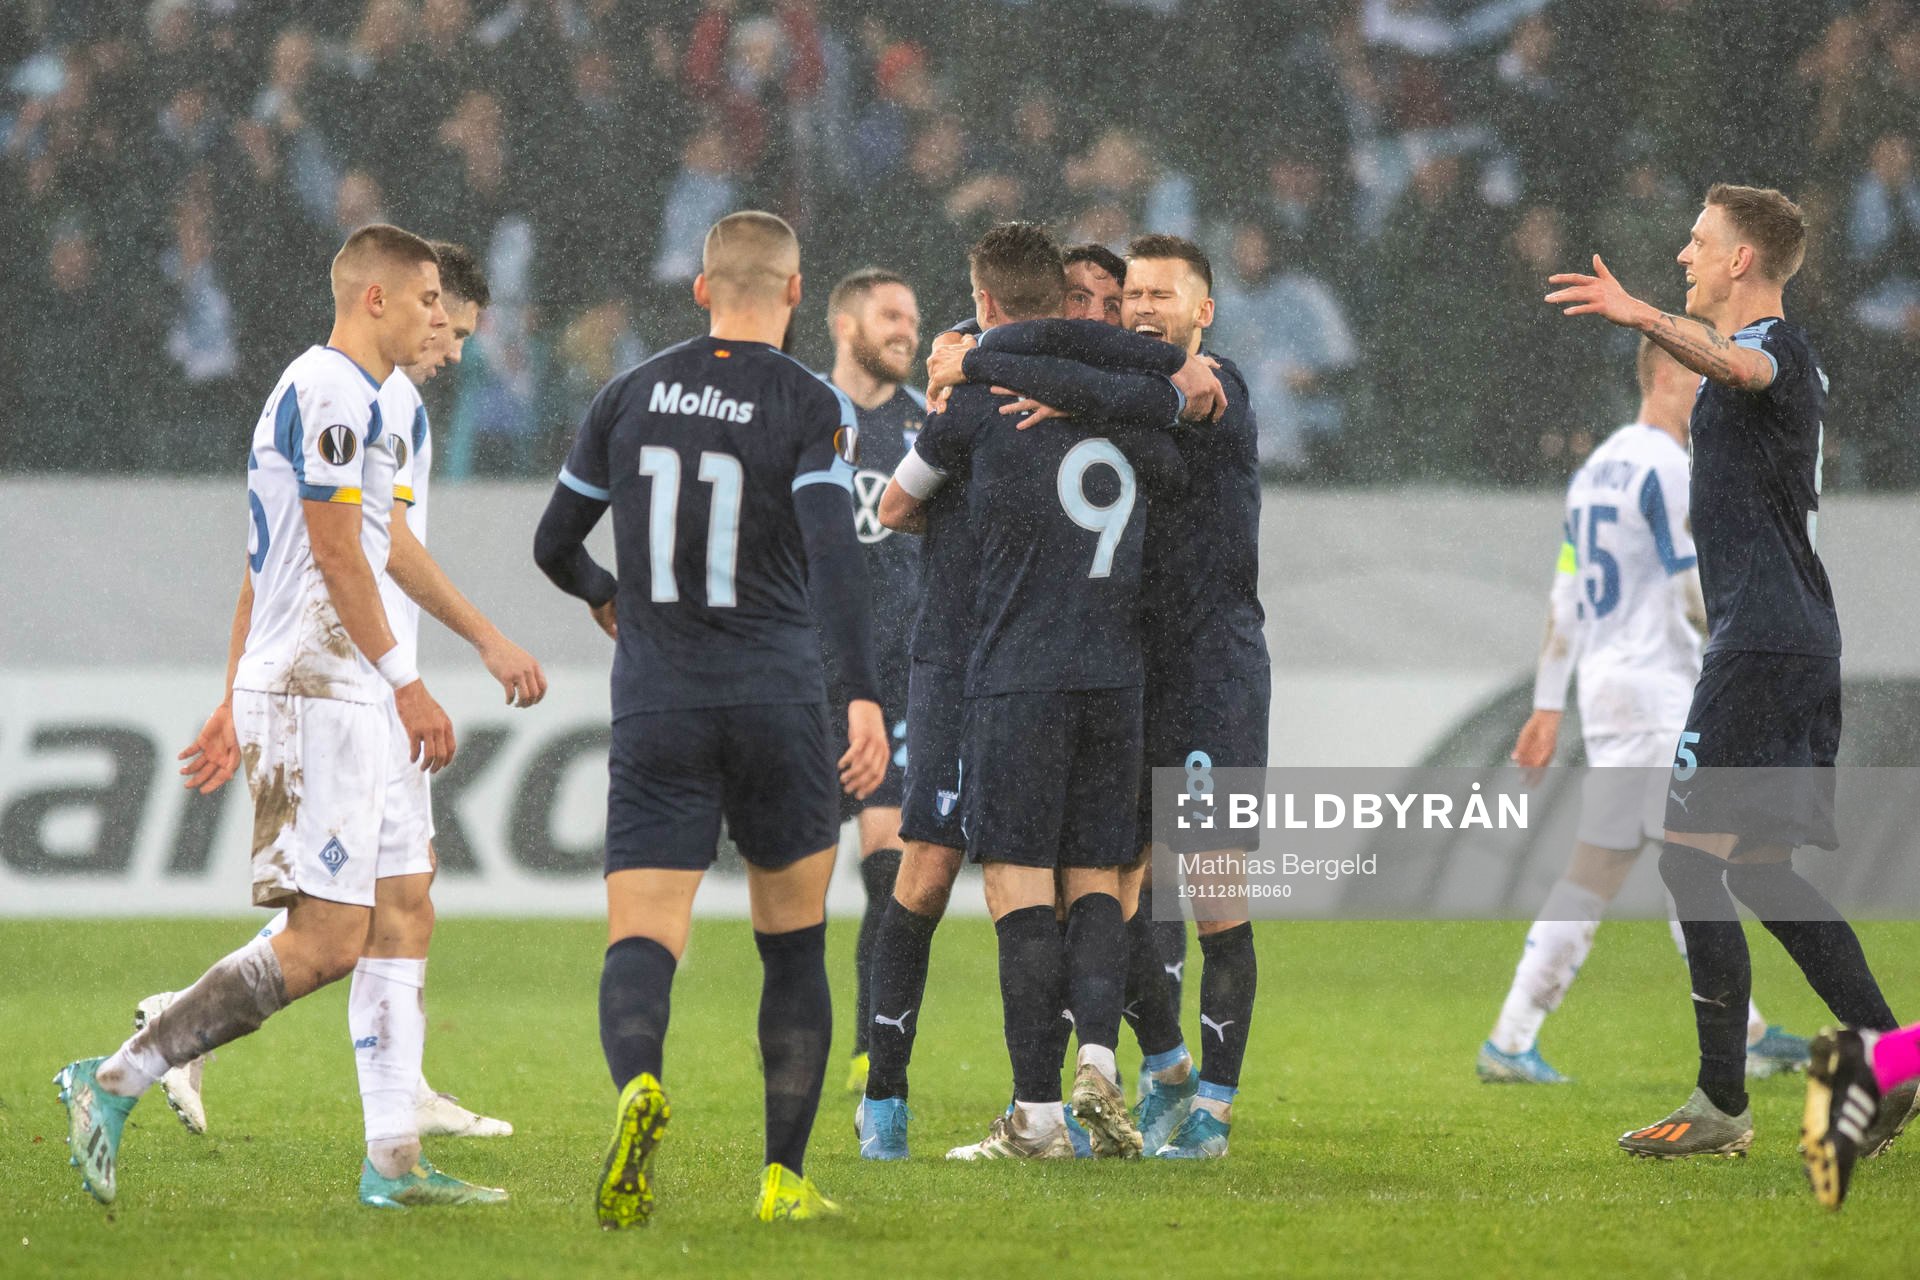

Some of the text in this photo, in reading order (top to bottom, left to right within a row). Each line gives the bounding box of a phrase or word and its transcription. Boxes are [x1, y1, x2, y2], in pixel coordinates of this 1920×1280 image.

[648, 381, 754, 424] Molins
[638, 445, 744, 608] 11
[1056, 437, 1136, 579] 9
[1184, 749, 1214, 801] 8
[1673, 731, 1701, 781] 5
